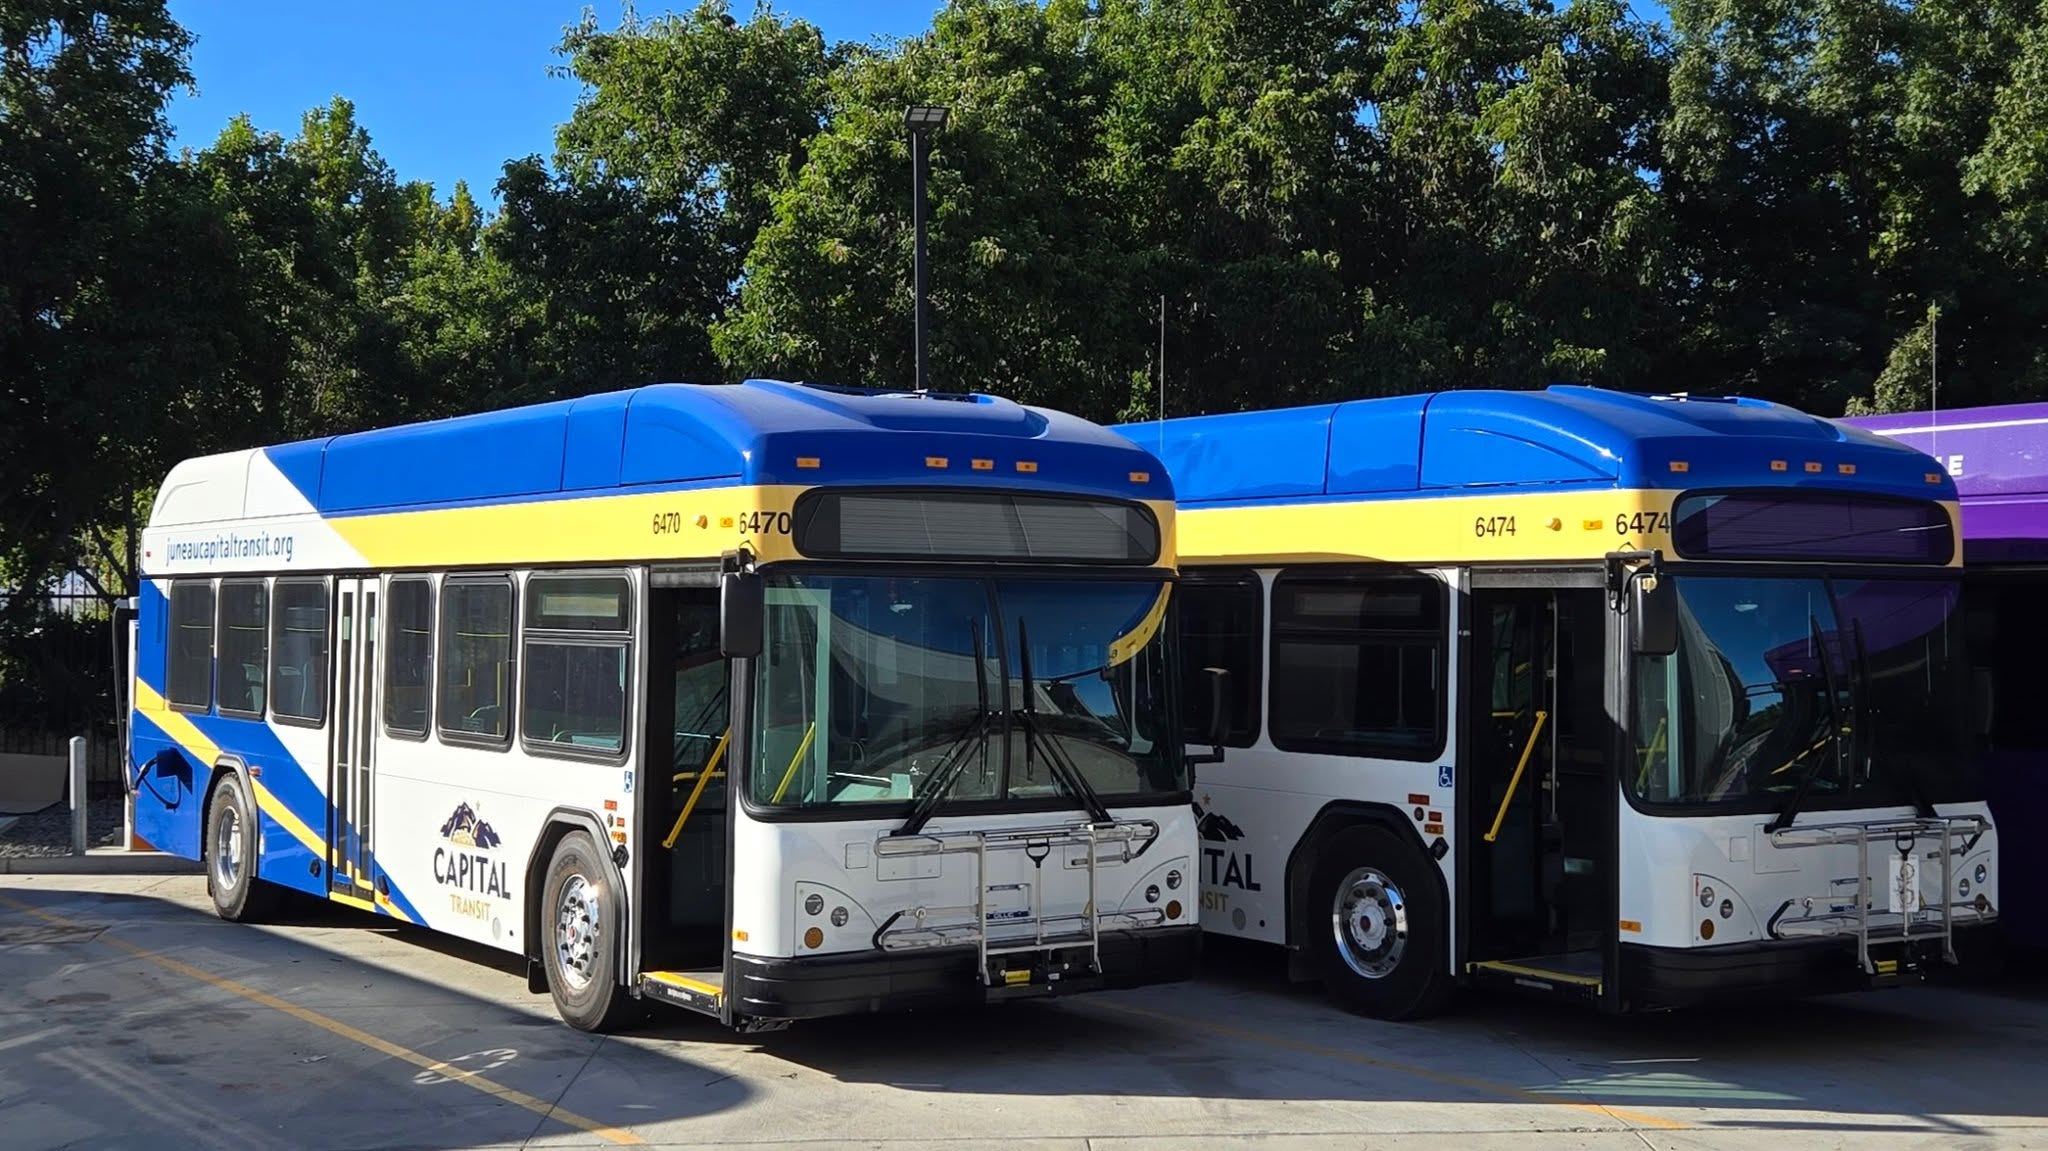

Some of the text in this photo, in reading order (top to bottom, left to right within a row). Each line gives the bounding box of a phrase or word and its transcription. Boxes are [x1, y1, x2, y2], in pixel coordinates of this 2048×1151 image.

[653, 512, 681, 535] 6470
[739, 511, 792, 535] 6470
[1475, 515, 1516, 537] 6474
[1616, 511, 1670, 535] 6474
[166, 530, 294, 567] juneaucapitaltransit.org
[434, 847, 511, 900] CAPITAL
[450, 893, 492, 921] TRANSIT
